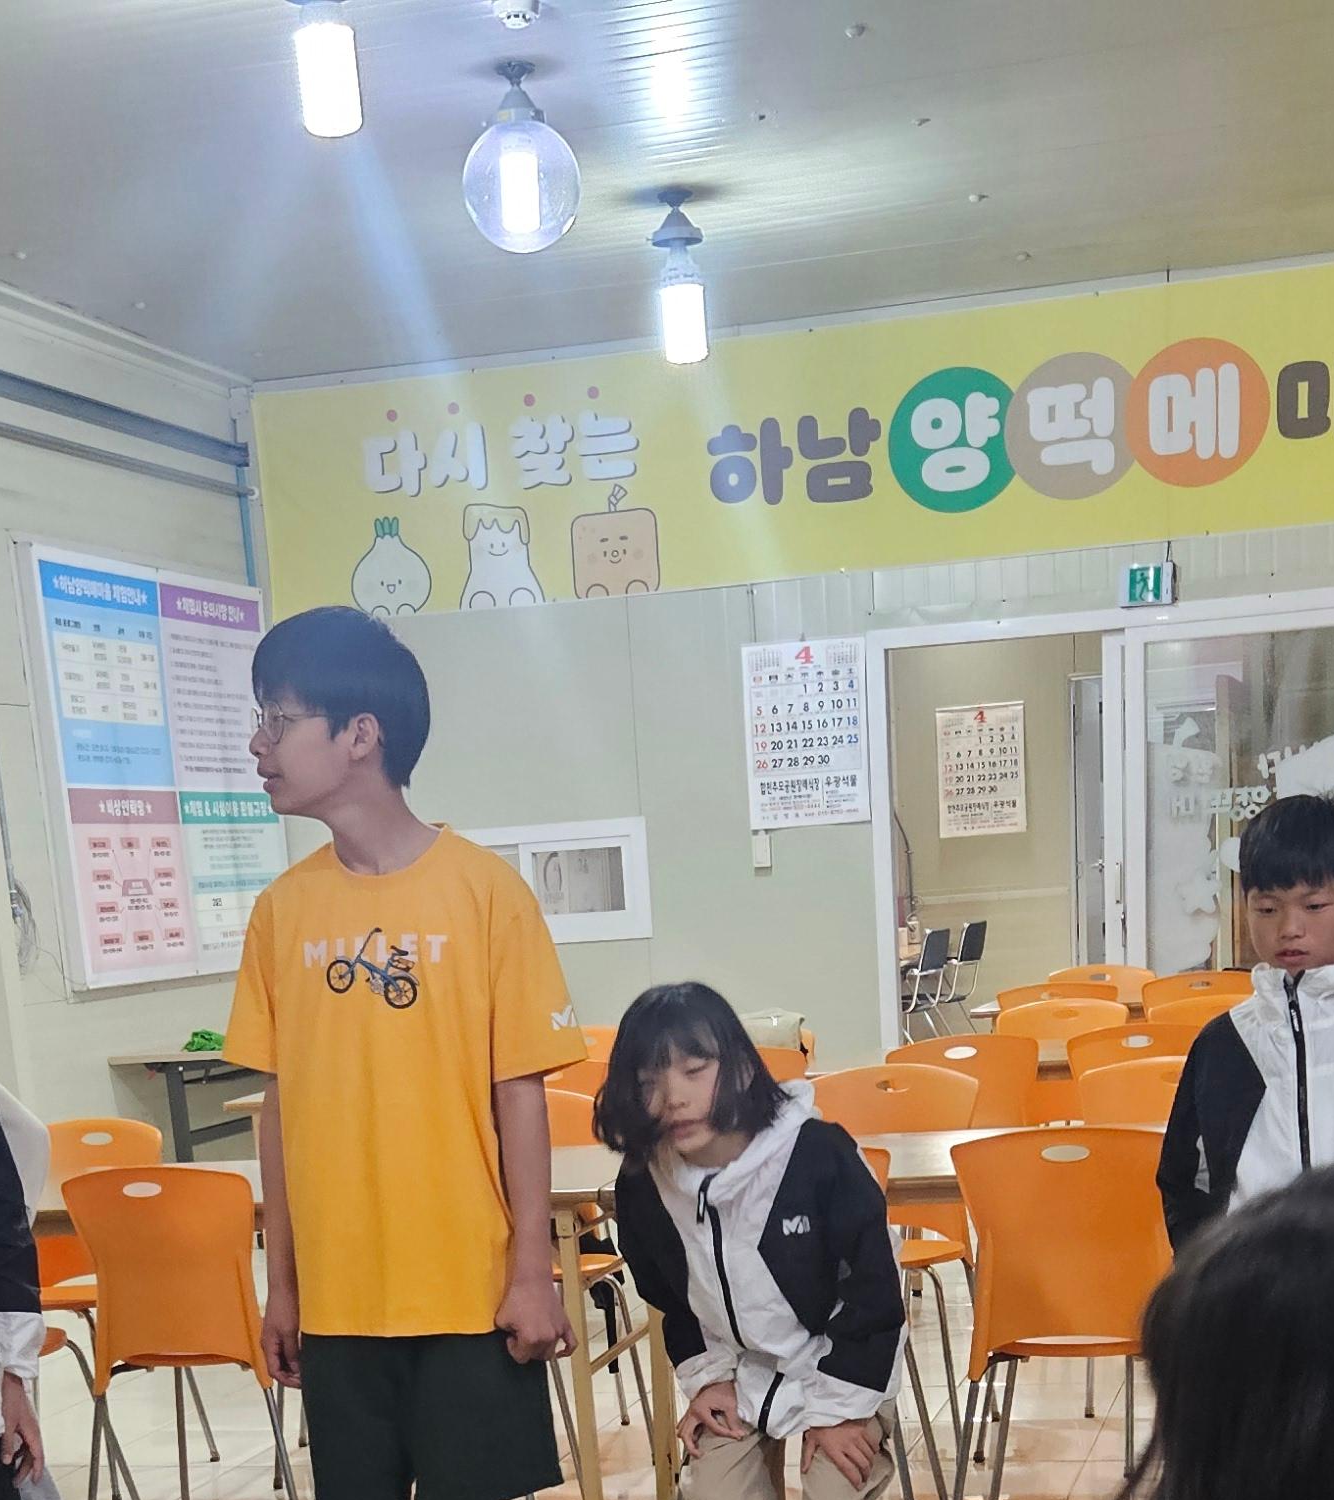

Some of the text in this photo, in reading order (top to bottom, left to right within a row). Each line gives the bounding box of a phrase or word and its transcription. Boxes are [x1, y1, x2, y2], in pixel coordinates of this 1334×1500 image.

[363, 421, 489, 497] 다시
[509, 409, 640, 492] 찾는
[794, 646, 814, 665] 4
[803, 680, 854, 694] 1 2 3 4
[756, 698, 857, 716] 5 6 7 8 9 10 11
[755, 716, 858, 733] 12 13 14 15 16 17 18
[973, 710, 987, 723] 4
[756, 734, 859, 751] 19 20 21 22 23 24 25
[756, 755, 830, 769] 26 27 28 29 30
[824, 774, 857, 788] 우광석물
[106, 799, 146, 817] 비상연락망
